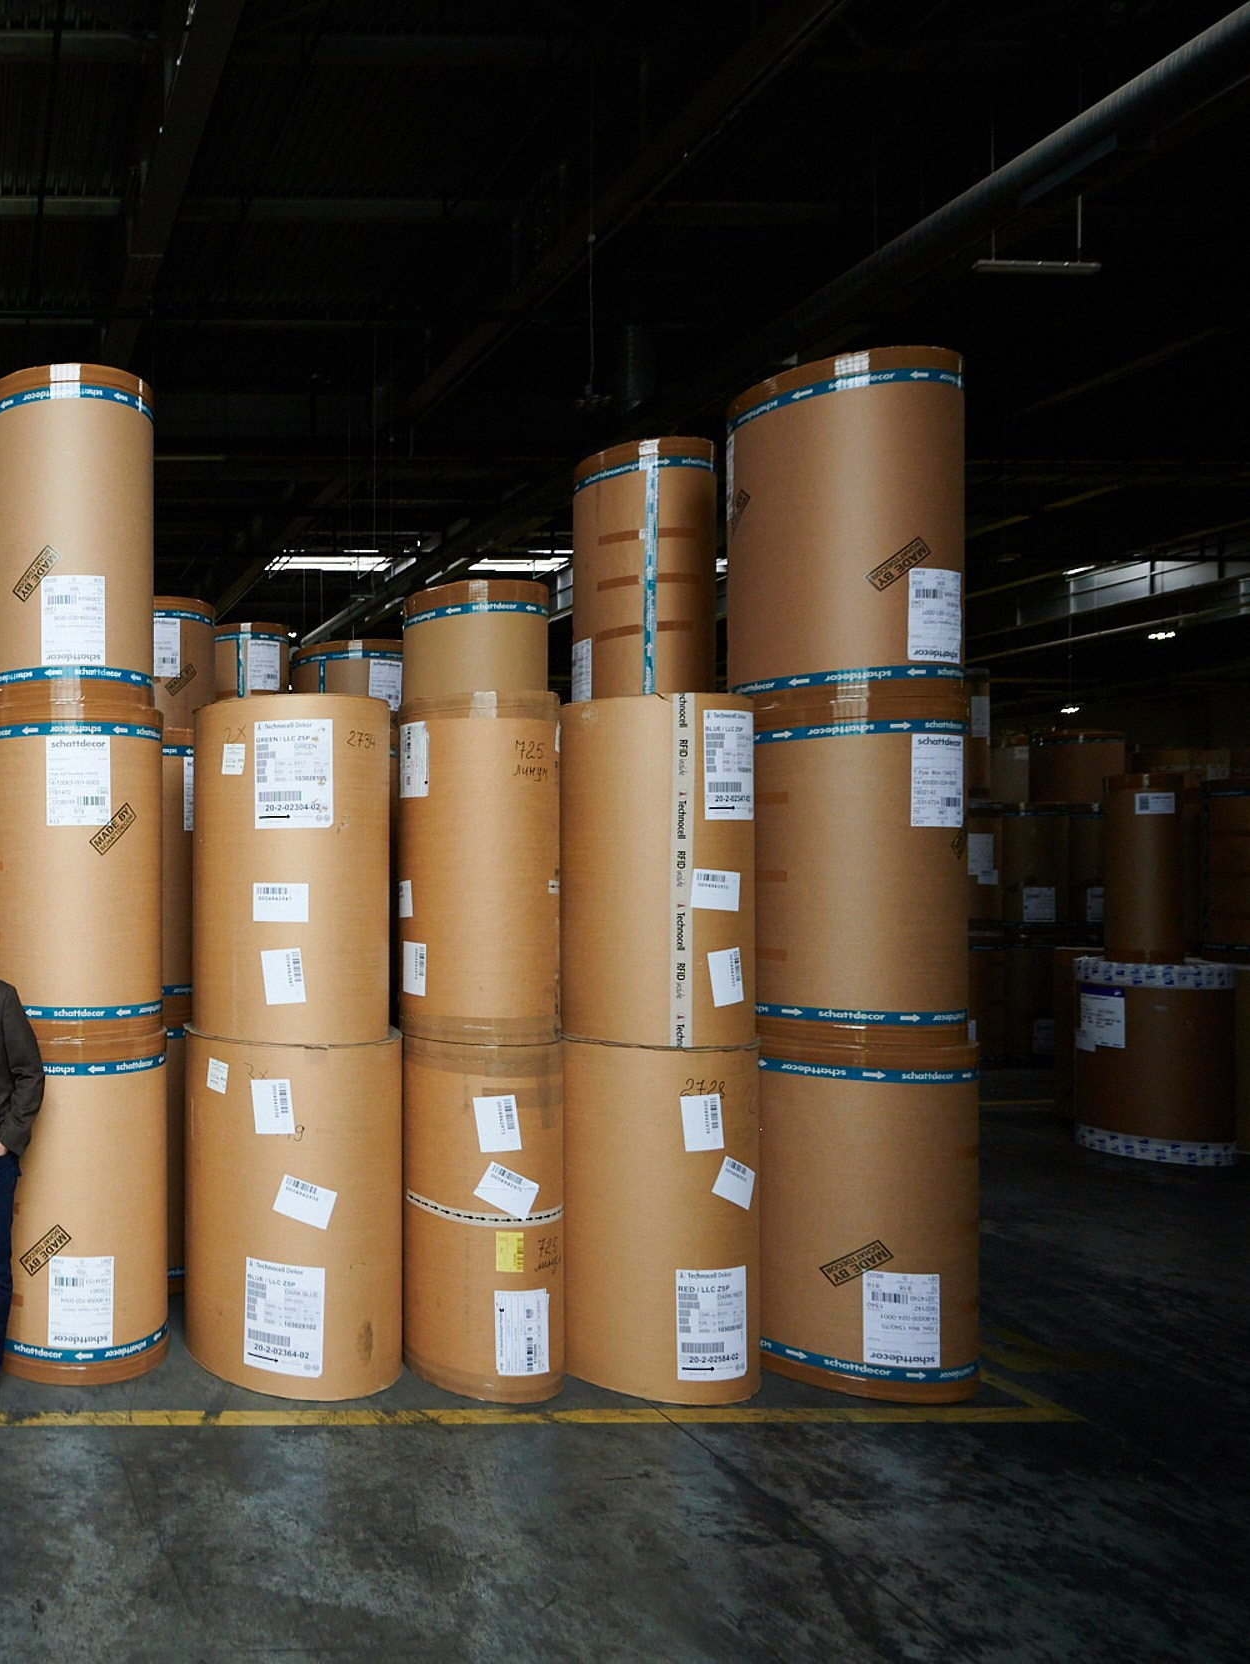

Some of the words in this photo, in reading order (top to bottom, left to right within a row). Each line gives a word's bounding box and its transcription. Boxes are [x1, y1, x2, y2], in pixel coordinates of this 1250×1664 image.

[895, 546, 926, 573] MADE
[878, 574, 894, 586] BY
[21, 581, 34, 598] BY
[472, 603, 517, 611] schattdecor
[47, 653, 100, 661] schattdecor
[75, 669, 121, 677] schattdecor
[825, 671, 892, 681] schattdecor
[808, 724, 874, 735] schattdecor
[51, 740, 105, 748] schattdecor
[347, 731, 375, 748] 2734
[917, 737, 961, 747] schattdecor
[679, 739, 688, 757] RFID
[677, 799, 687, 840] Technocell
[94, 819, 118, 846] MADE
[118, 808, 130, 820] BY
[677, 850, 686, 870] RFID
[677, 912, 685, 950] Technocell
[677, 963, 685, 981] RFID
[819, 1010, 885, 1021] schattdecor
[116, 1060, 153, 1070] schattdecor
[781, 1063, 846, 1076] schattdecor
[902, 1071, 954, 1080] schattdecor
[680, 1078, 725, 1098] 2728
[39, 1232, 68, 1259] MADE
[28, 1258, 41, 1272] BY
[854, 1248, 888, 1273] MADE
[256, 1262, 285, 1273] Technocell
[248, 1274, 263, 1282] BLUE
[269, 1278, 281, 1286] LLC
[834, 1270, 850, 1283] BY
[52, 1335, 108, 1344] schattdecor
[14, 1344, 63, 1359] schattdecor
[105, 1341, 146, 1358] schattdecor
[870, 1353, 936, 1364] schattdecor
[823, 1358, 892, 1377] schattdecor
